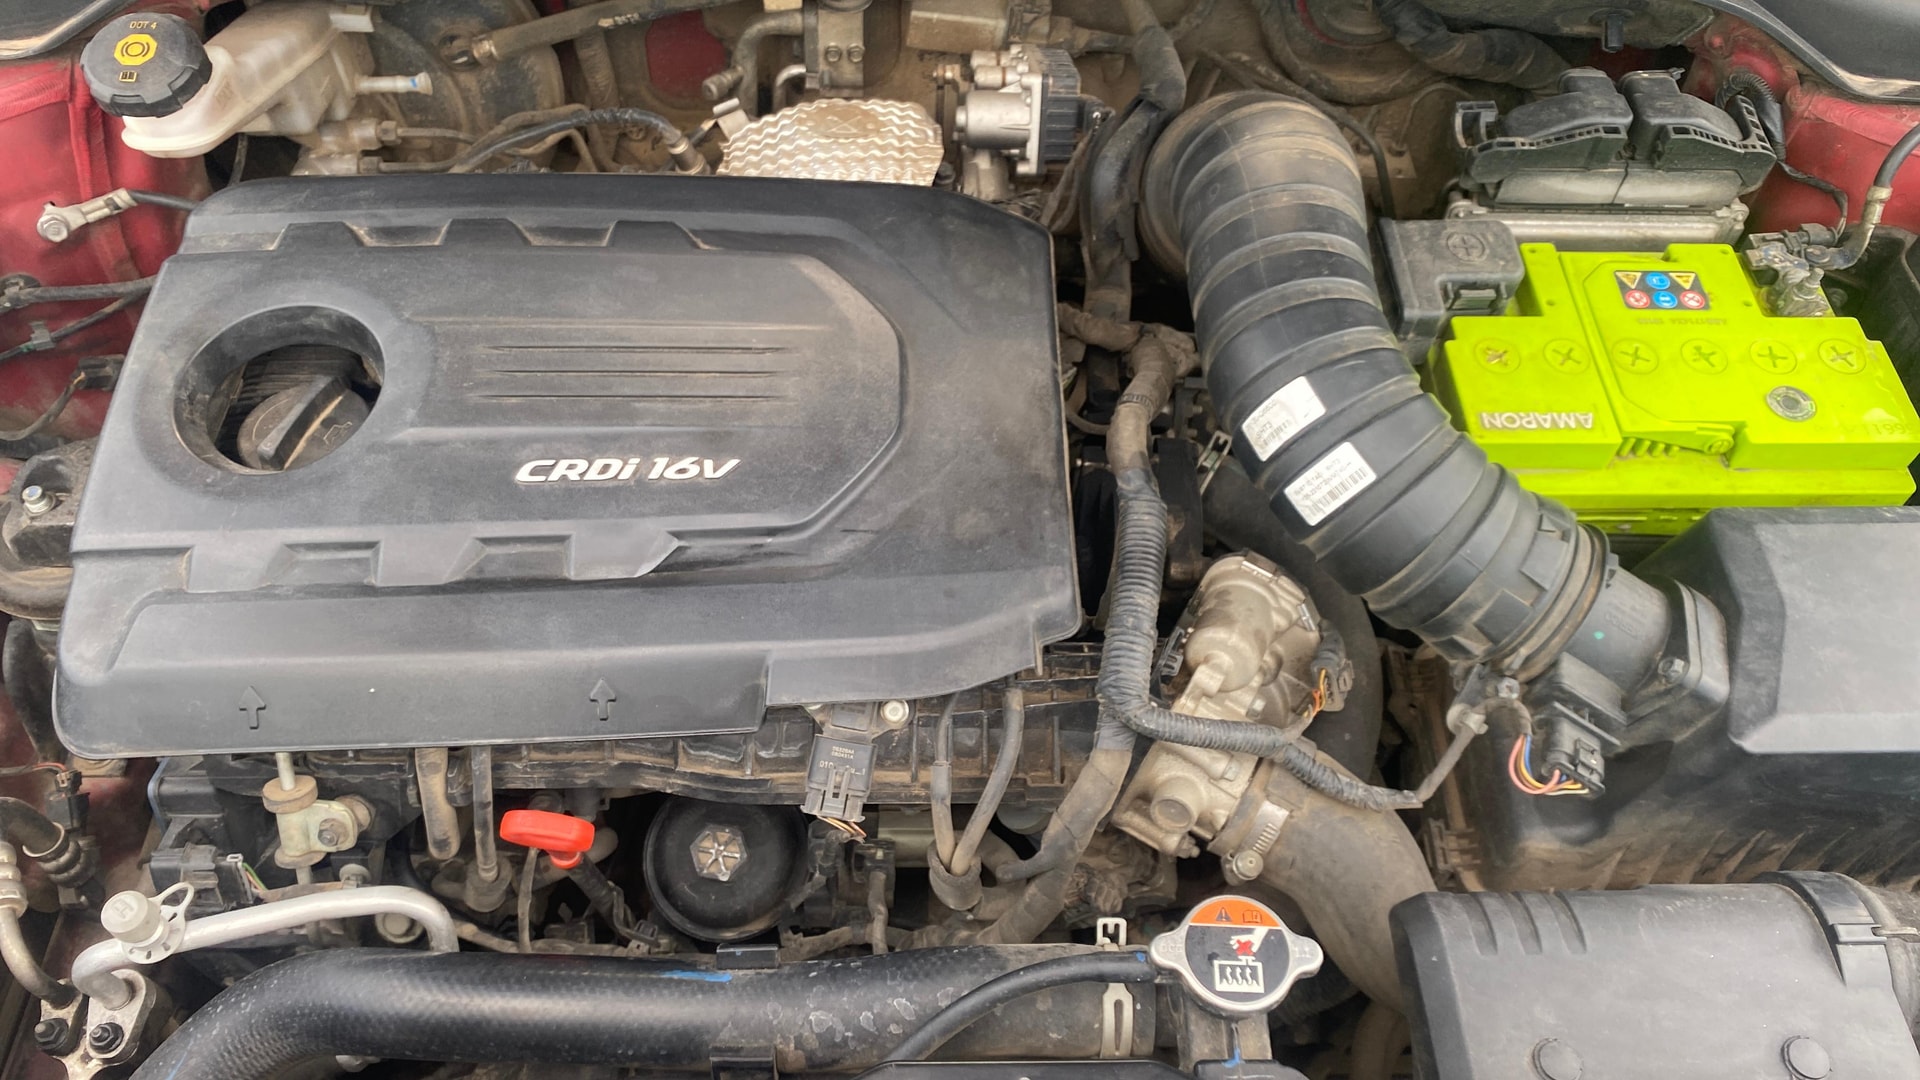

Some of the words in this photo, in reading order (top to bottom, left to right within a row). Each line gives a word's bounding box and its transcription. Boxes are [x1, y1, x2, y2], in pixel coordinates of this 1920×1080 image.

[130, 20, 149, 29] DOT
[150, 21, 158, 30] 4
[1481, 411, 1593, 429] AMARON
[515, 458, 641, 482] CRDi
[648, 456, 742, 480] 16V
